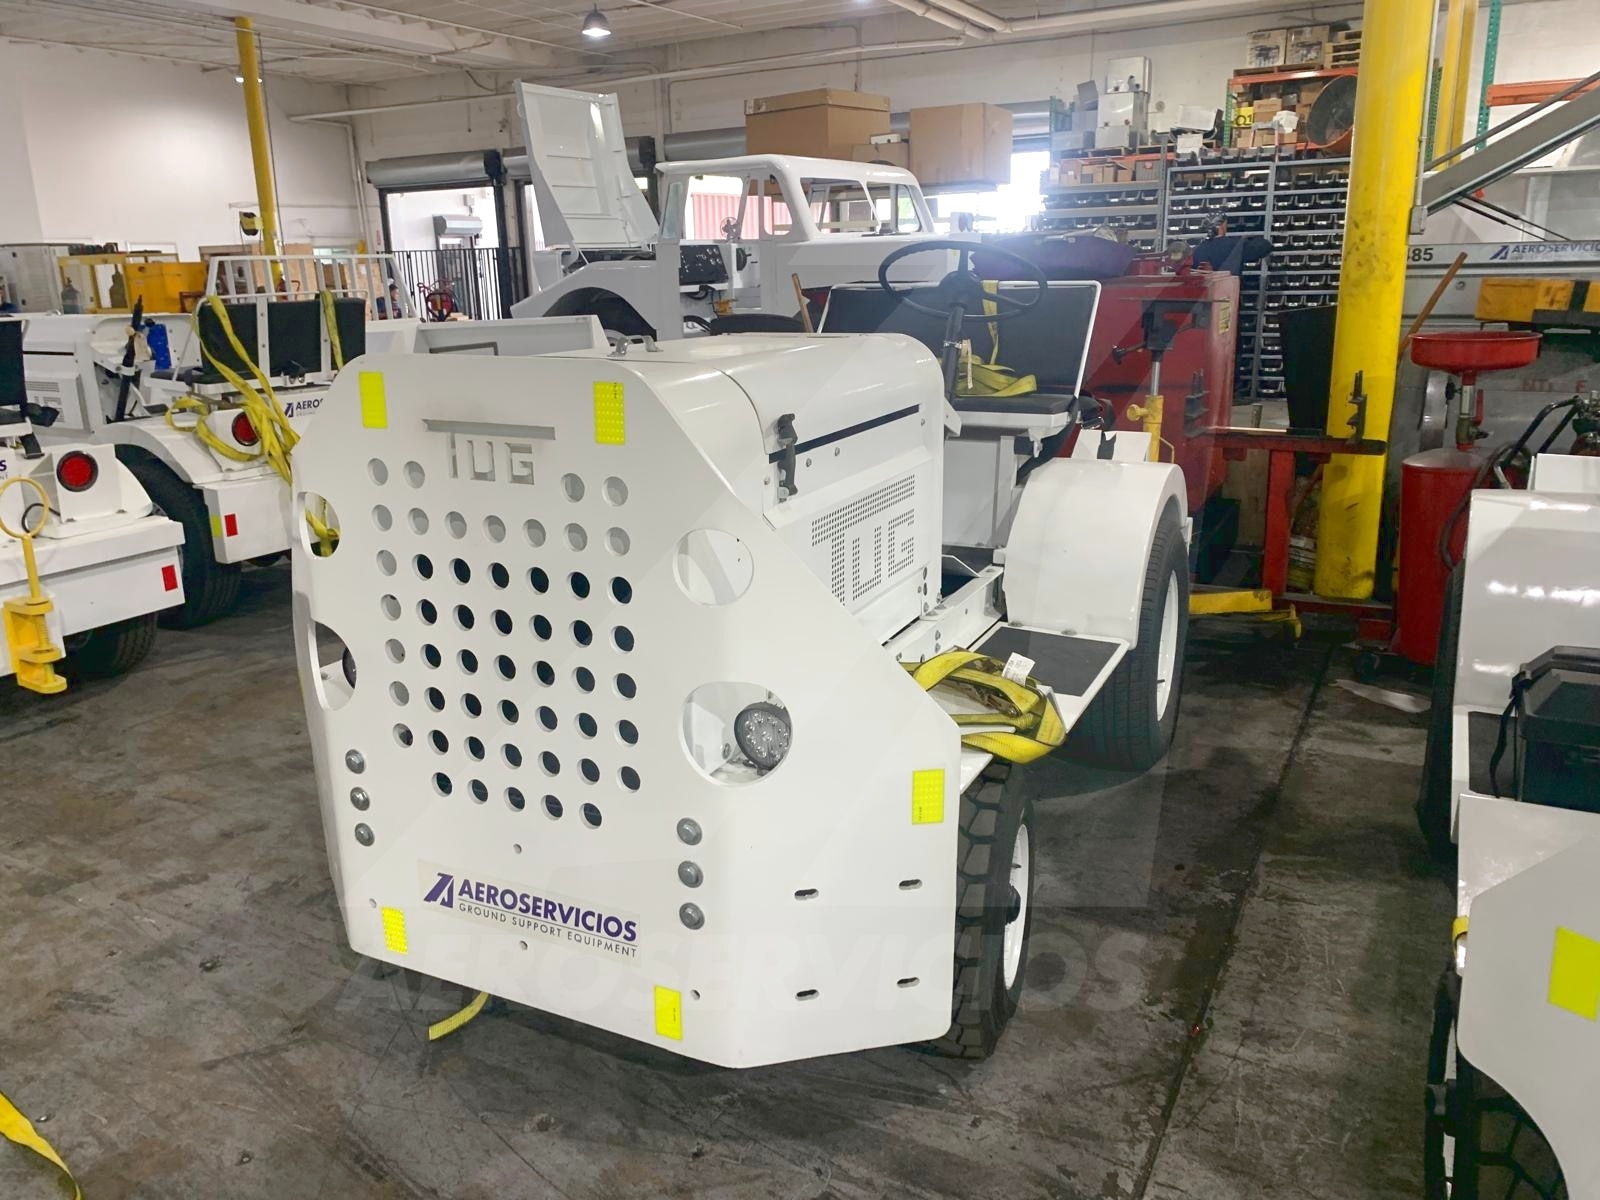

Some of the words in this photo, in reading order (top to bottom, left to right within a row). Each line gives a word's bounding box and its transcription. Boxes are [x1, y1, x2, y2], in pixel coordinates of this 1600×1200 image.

[1407, 247, 1434, 262] 85
[296, 398, 323, 410] AERO
[421, 418, 556, 485] TUG
[811, 474, 915, 606] TUG
[458, 878, 638, 942] AEROSERVICIOS
[458, 902, 507, 923] GROUND
[511, 916, 562, 938] SUPPORT
[567, 931, 638, 958] EQUIPMENT
